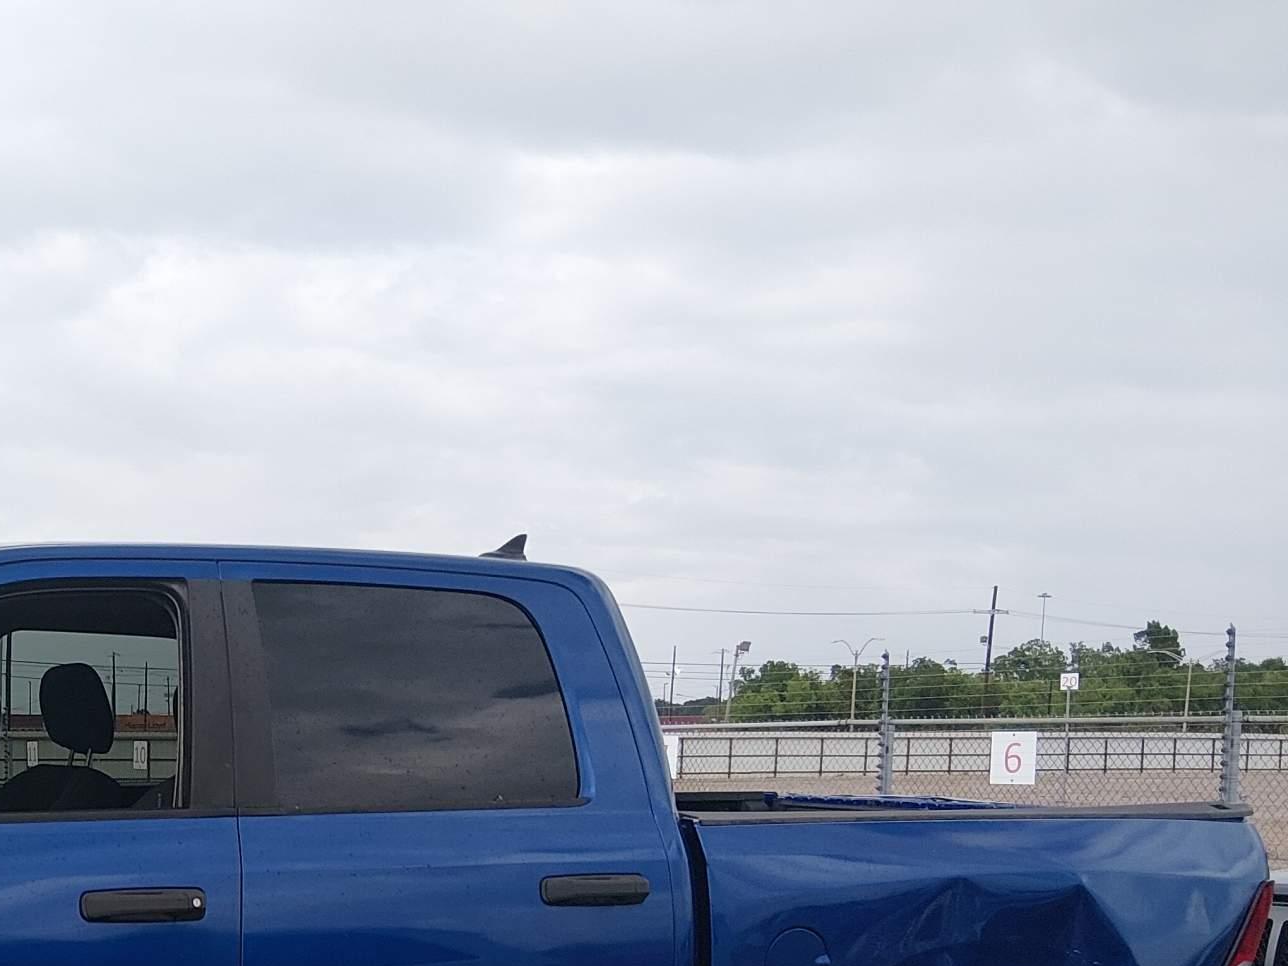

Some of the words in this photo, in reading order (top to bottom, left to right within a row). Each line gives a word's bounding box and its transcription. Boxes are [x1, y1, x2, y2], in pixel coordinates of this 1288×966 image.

[1062, 676, 1077, 688] 20
[134, 746, 146, 764] 10
[1004, 742, 1022, 774] 6
